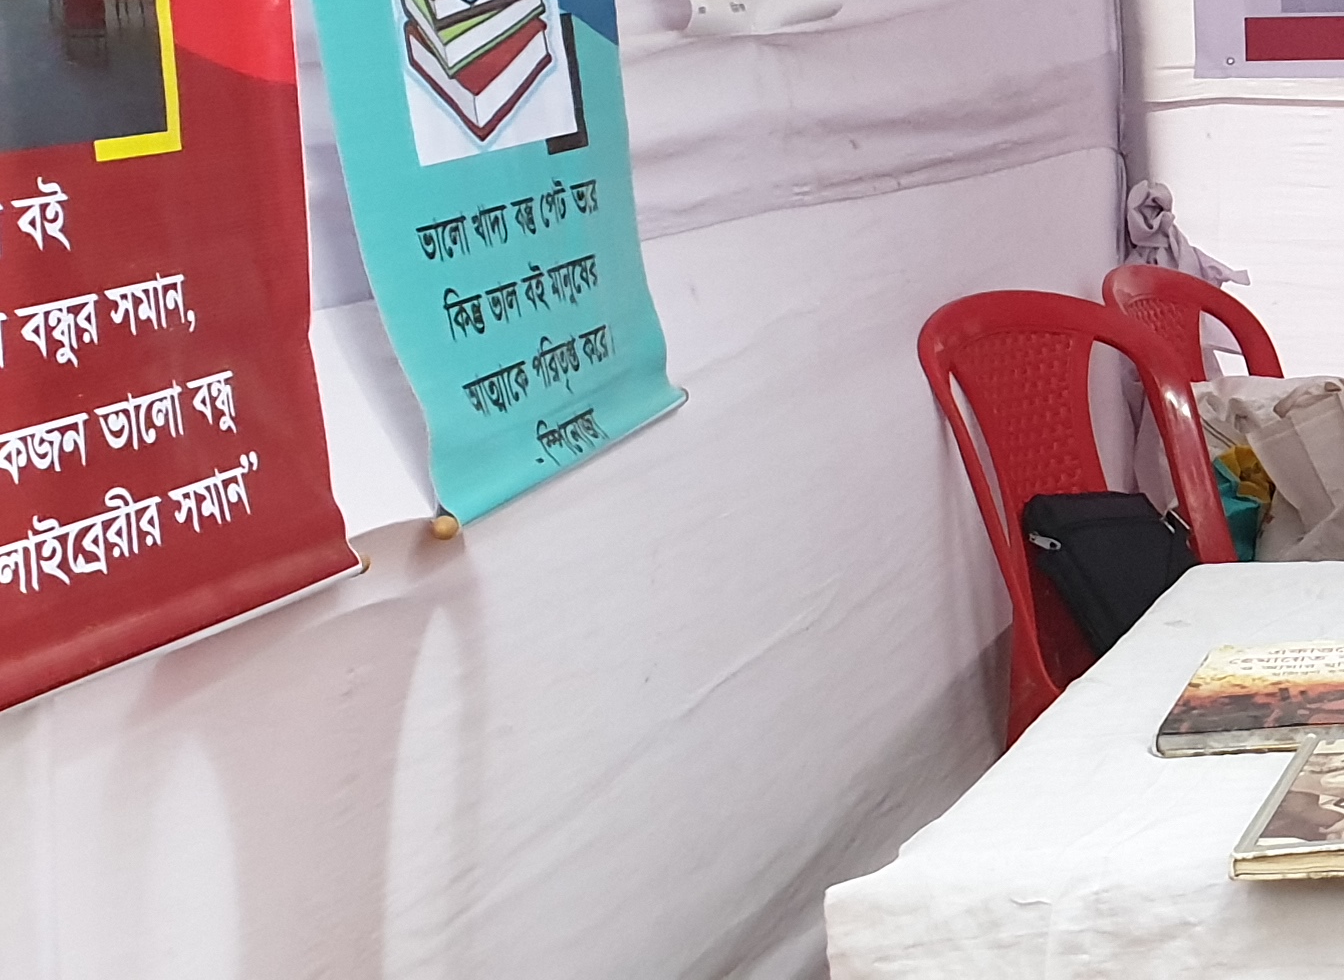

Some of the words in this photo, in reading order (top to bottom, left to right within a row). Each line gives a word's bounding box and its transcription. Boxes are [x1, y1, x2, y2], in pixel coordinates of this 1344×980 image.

[12, 177, 70, 251] বই
[416, 215, 472, 261] ভালো
[521, 261, 550, 311] বই
[15, 292, 98, 367] বন্ধুর
[94, 380, 183, 450] ভালো
[187, 369, 237, 434] বন্ধু
